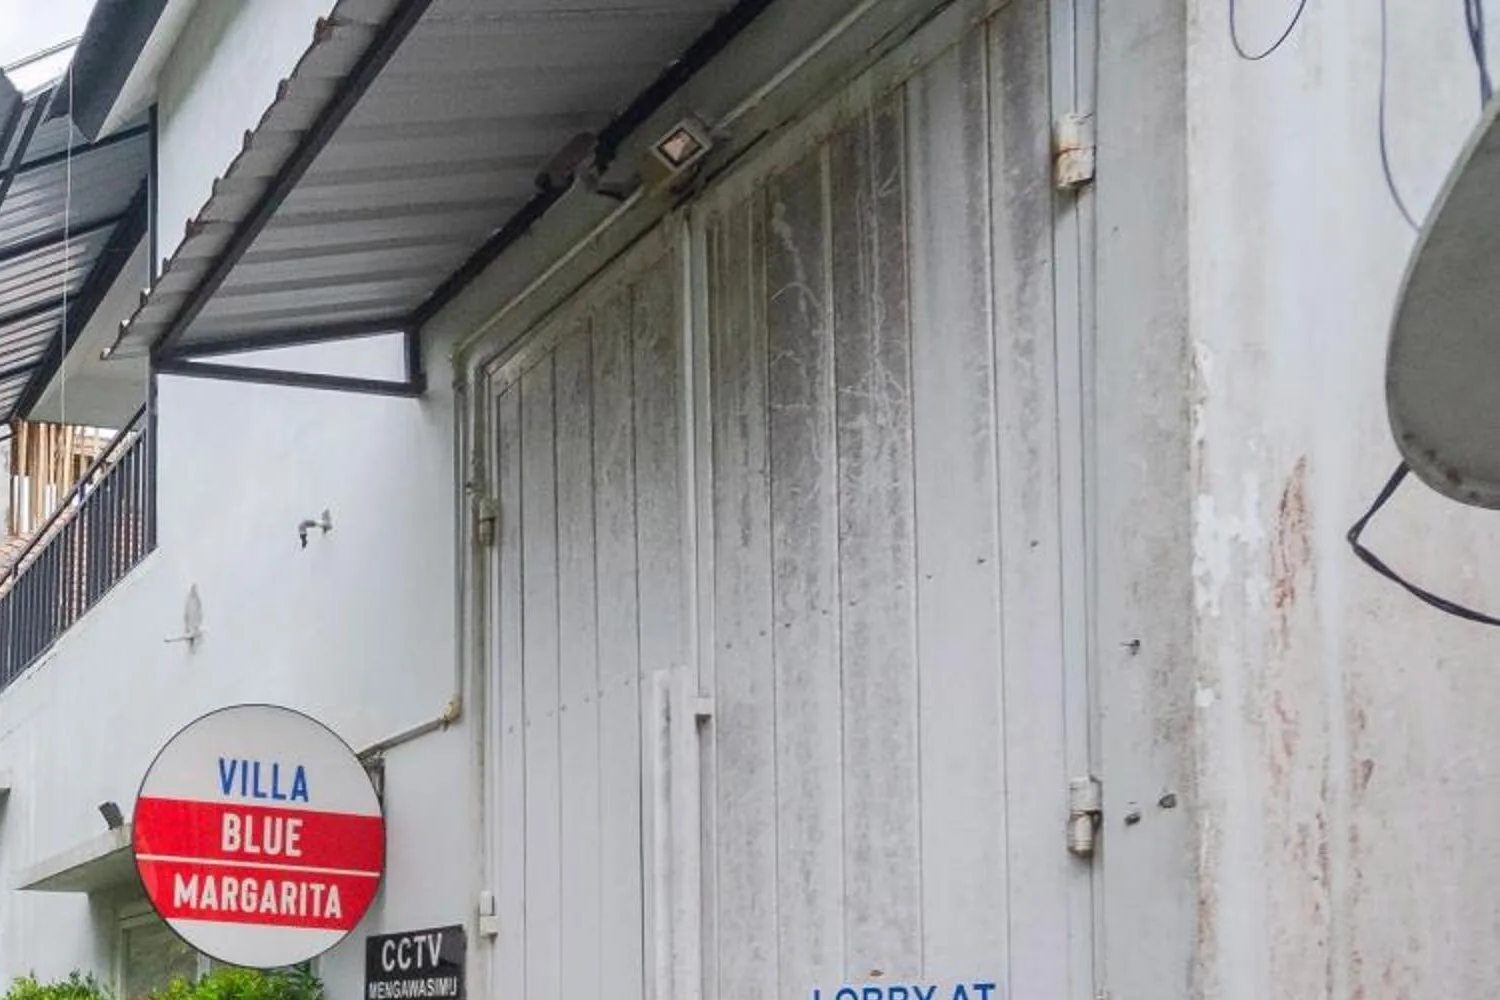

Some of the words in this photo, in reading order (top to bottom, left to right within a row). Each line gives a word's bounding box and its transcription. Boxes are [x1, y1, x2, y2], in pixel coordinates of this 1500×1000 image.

[218, 756, 309, 802] VILLA
[221, 813, 303, 857] BLUE
[173, 872, 342, 919] MARGARITA
[381, 932, 443, 972] CCTV
[368, 976, 457, 999] MENGAWASIMU
